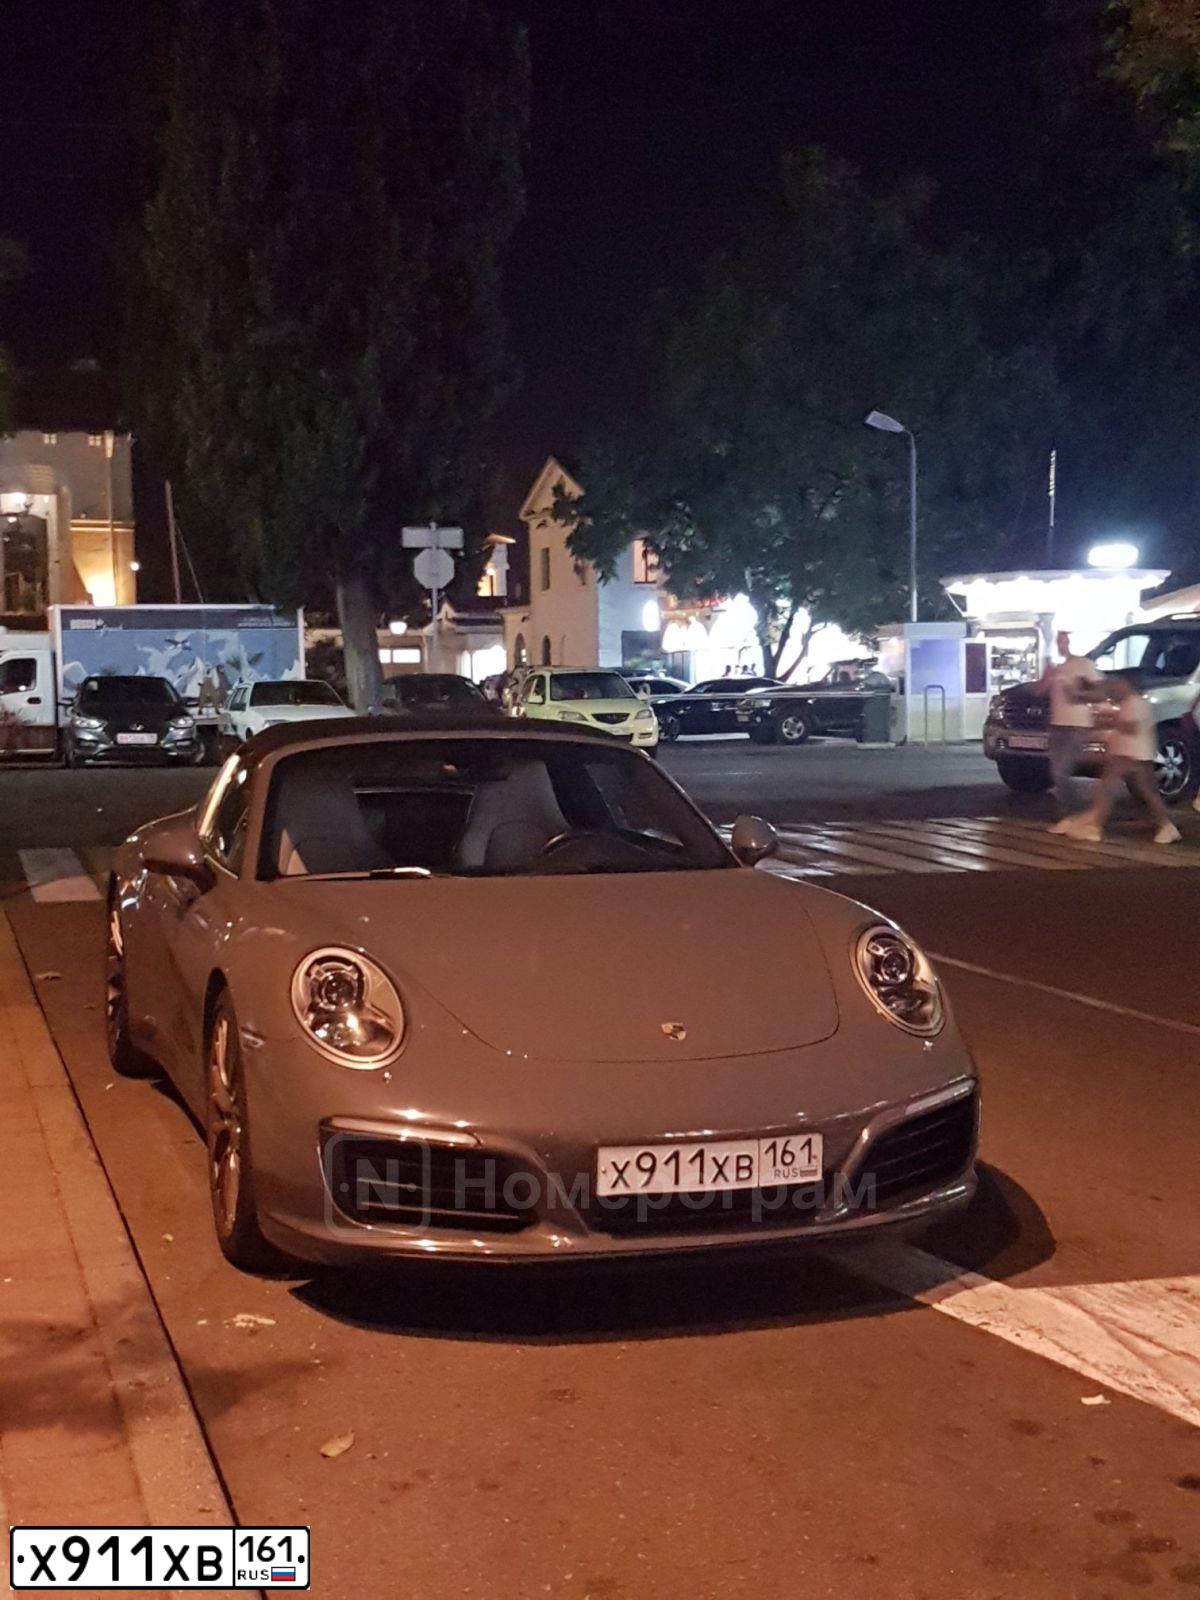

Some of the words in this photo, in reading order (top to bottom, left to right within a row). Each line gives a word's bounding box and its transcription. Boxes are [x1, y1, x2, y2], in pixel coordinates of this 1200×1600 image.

[610, 1147, 754, 1189] Х911ХВ
[764, 1137, 813, 1168] 161
[773, 1167, 800, 1179] RUS
